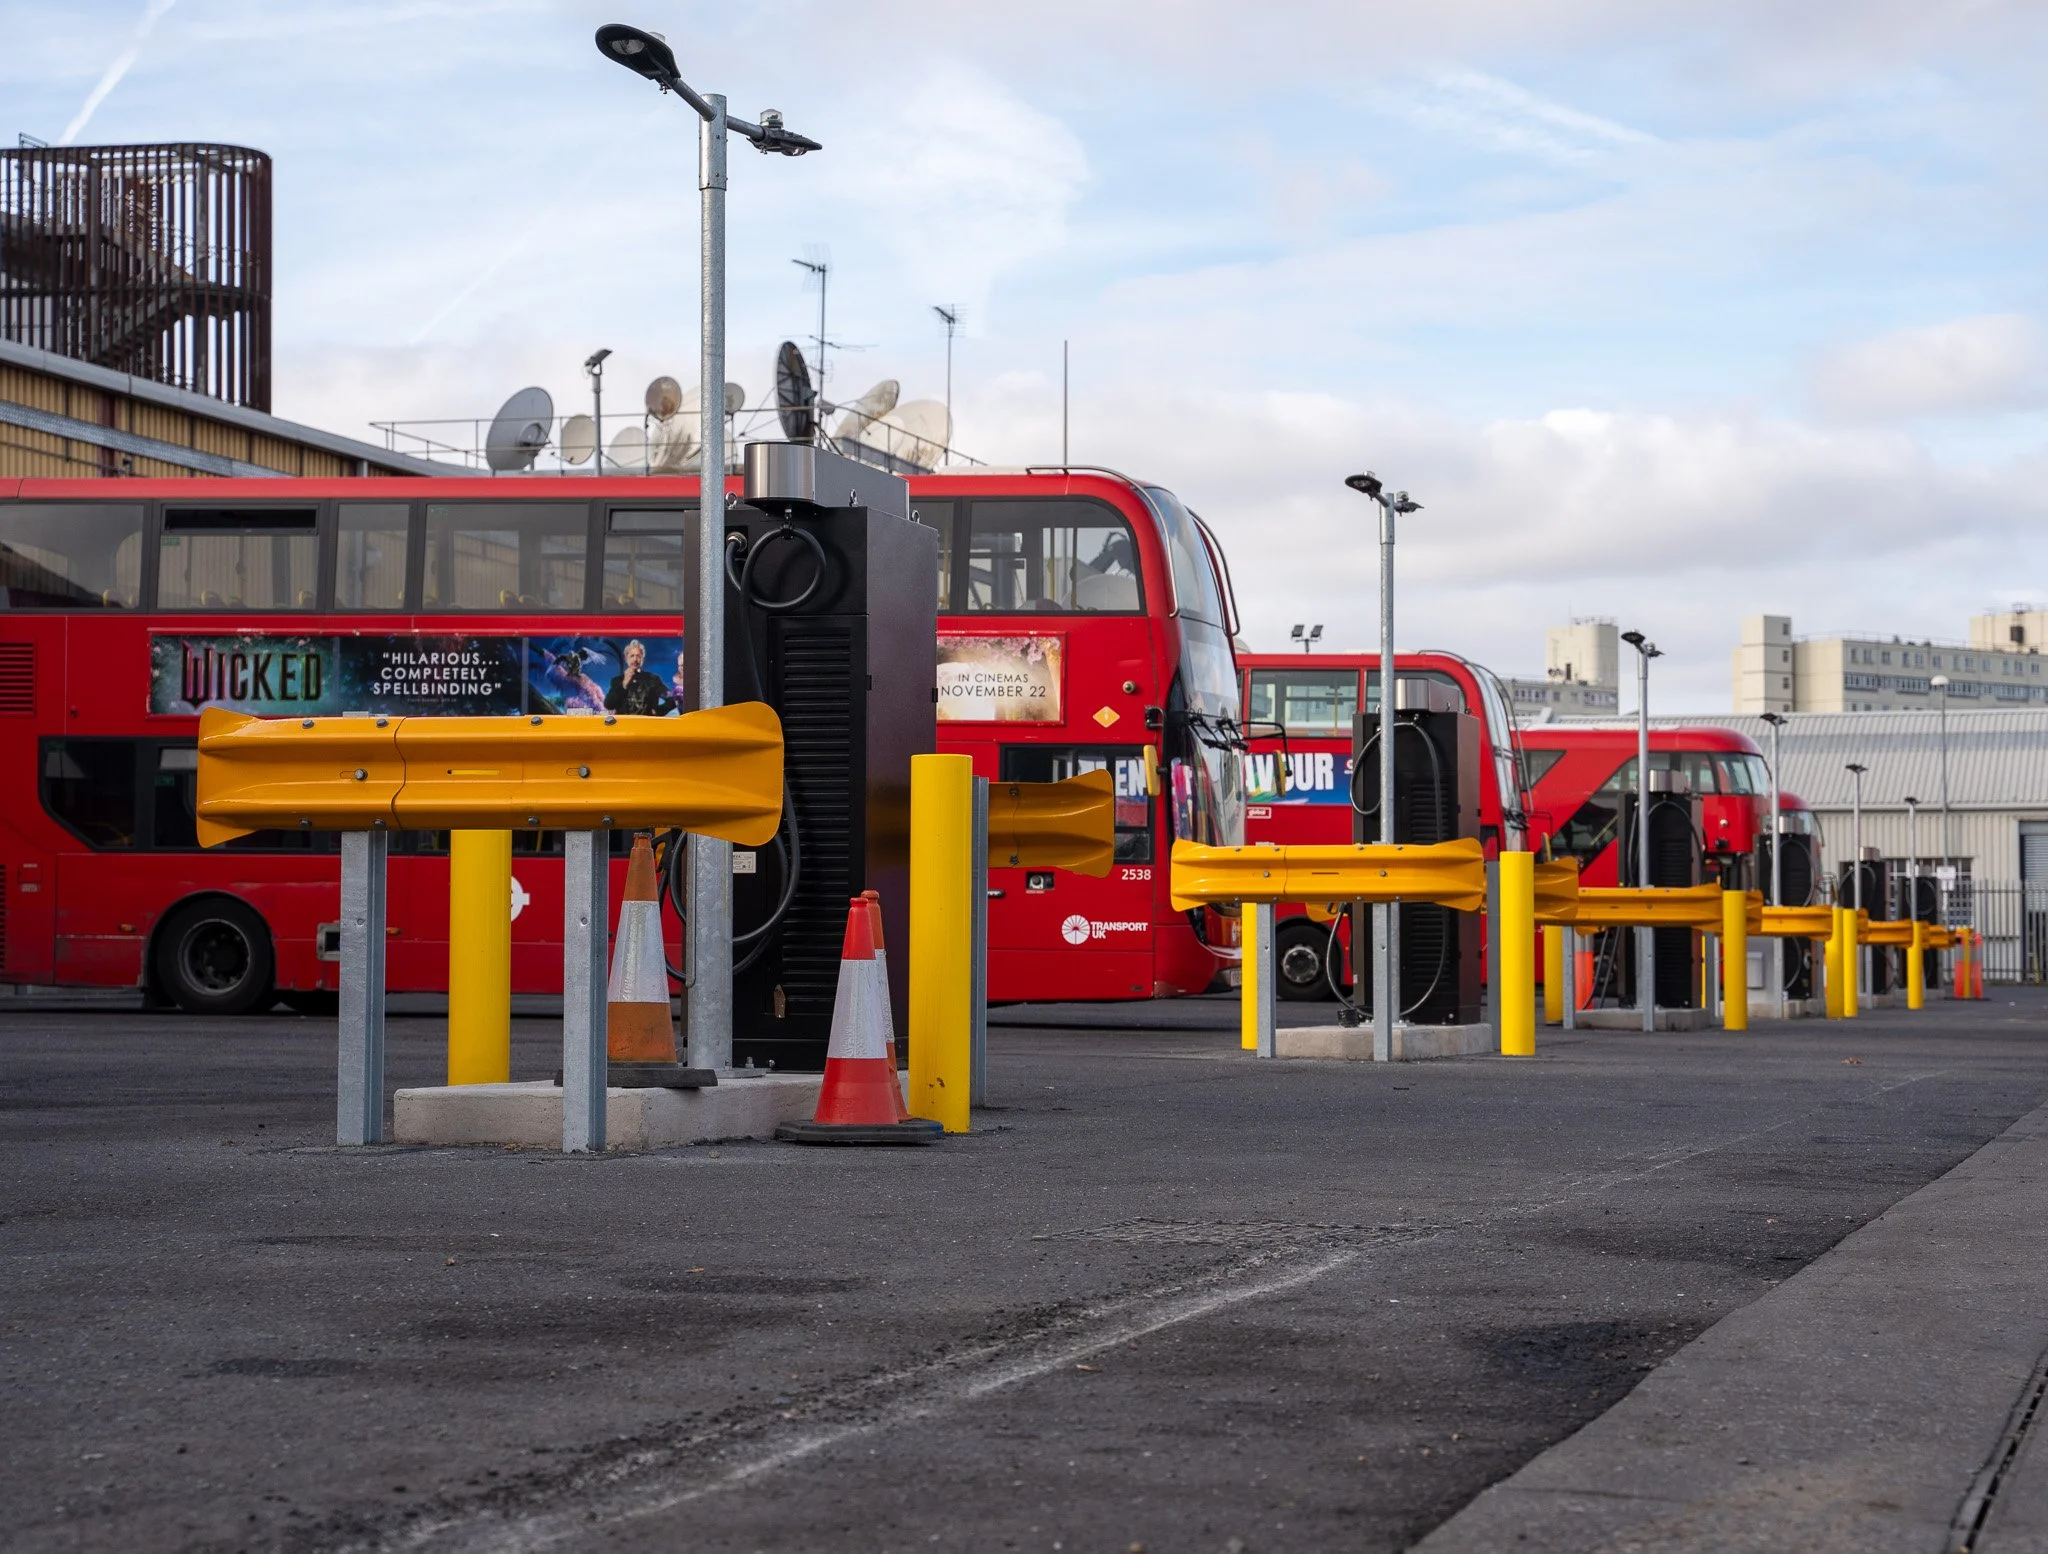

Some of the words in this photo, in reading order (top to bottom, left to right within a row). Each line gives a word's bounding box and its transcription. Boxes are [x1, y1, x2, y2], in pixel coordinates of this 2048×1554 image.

[382, 652, 499, 665] "HILARIOUS...
[181, 640, 321, 708] WICKED
[381, 667, 487, 680] COMPLETELY
[958, 674, 970, 682] IN
[975, 674, 1029, 683] CINEMAS
[373, 682, 501, 695] SPELLBINDING"
[941, 685, 1023, 697] NOVEMBER
[1030, 685, 1046, 697] 22
[1121, 868, 1151, 881] 2538
[1090, 921, 1148, 932] TRANSPORT
[1092, 930, 1106, 939] UK
